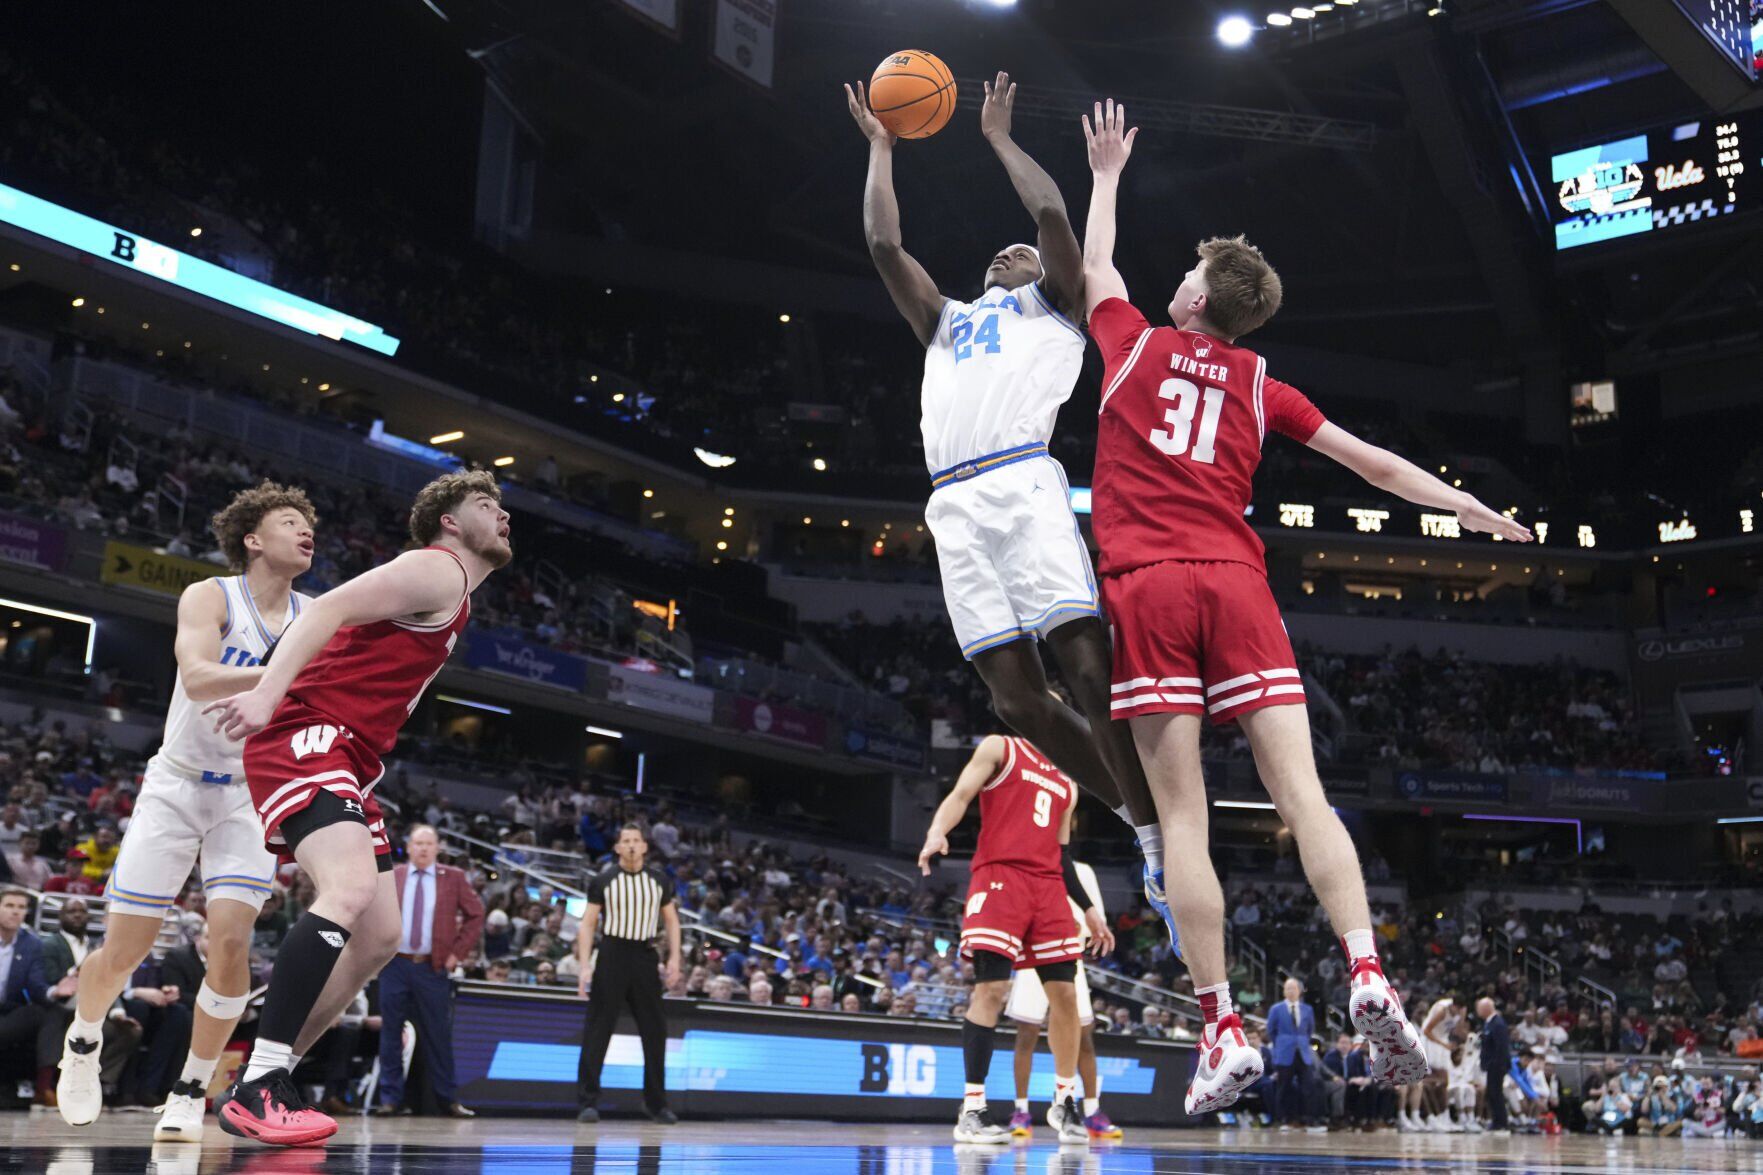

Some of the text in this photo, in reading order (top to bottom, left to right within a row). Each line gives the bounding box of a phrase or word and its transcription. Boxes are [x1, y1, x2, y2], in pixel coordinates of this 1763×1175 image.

[1654, 160, 1705, 191] Ucla
[952, 314, 1001, 365] 24
[1170, 353, 1228, 382] WINTER
[1149, 378, 1226, 464] 31
[1658, 519, 1697, 542] Ucla
[1666, 636, 1744, 654] LEXUS
[290, 724, 338, 760] W
[1427, 781, 1460, 792] Sports
[1461, 781, 1485, 793] Tech
[1576, 786, 1630, 801] DONUTS
[1032, 789, 1053, 827] 9
